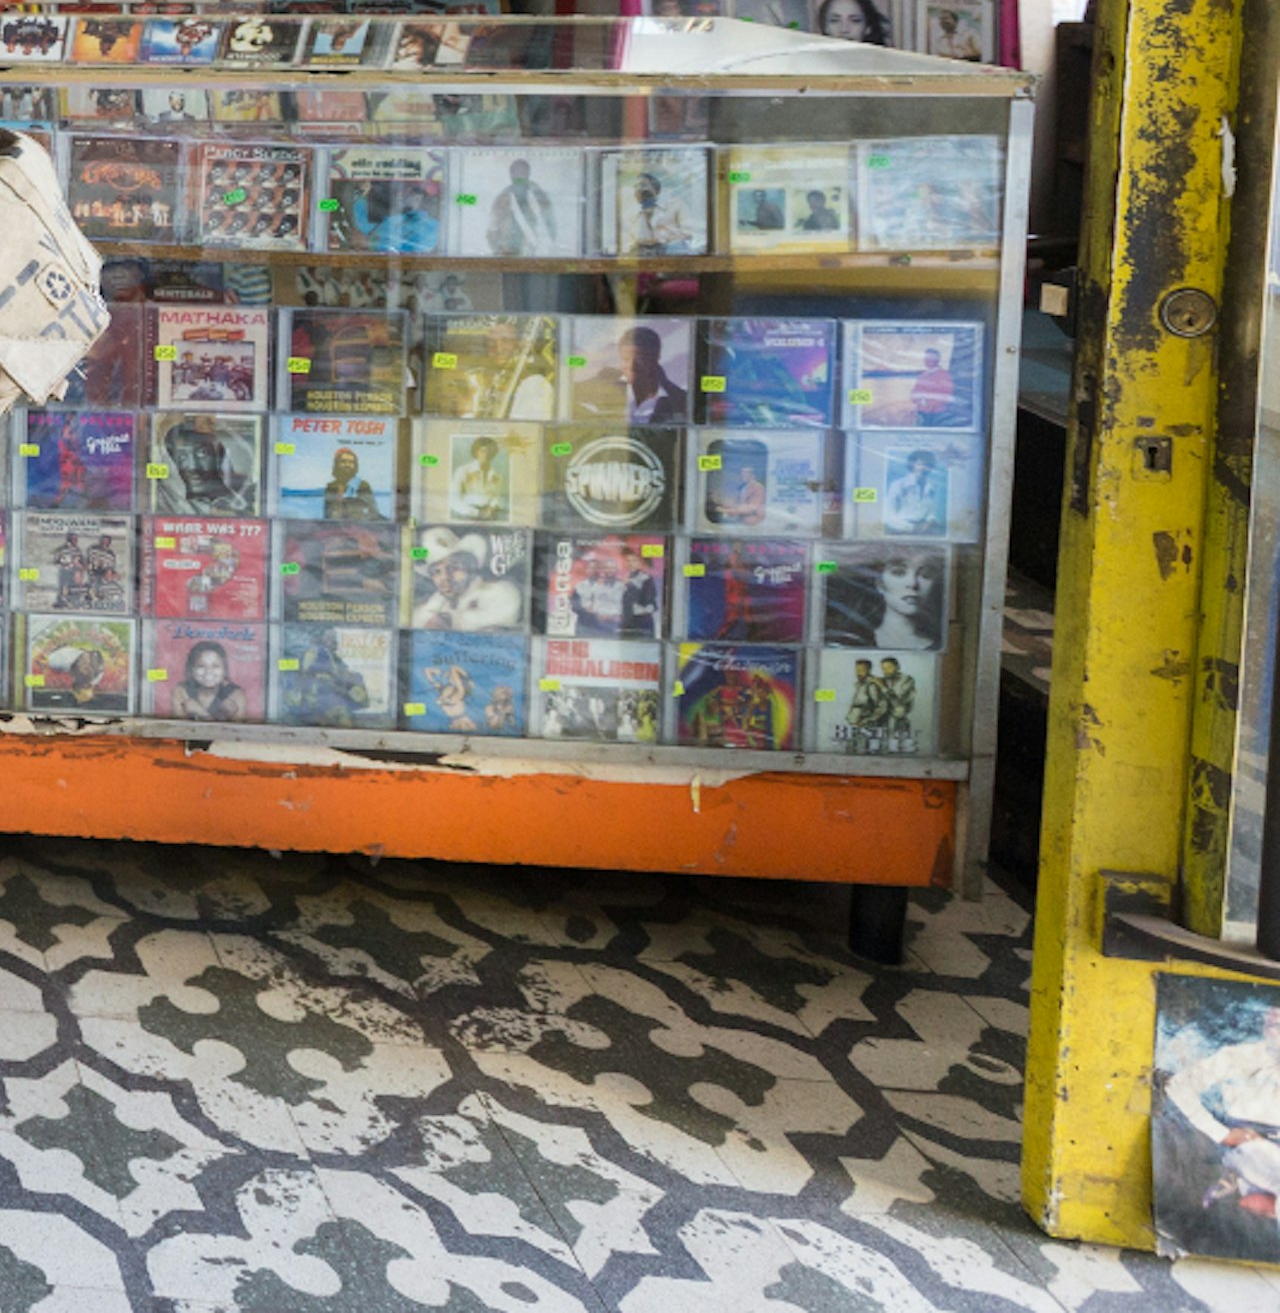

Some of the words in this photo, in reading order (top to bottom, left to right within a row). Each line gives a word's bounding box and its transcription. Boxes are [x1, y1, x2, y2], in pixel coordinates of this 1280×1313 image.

[159, 311, 266, 325] MATHAKA
[291, 418, 341, 434] PETER
[346, 419, 385, 434] TOSH
[565, 461, 664, 503] SPINNERS
[163, 522, 202, 536] WAAR
[207, 523, 236, 536] WAS
